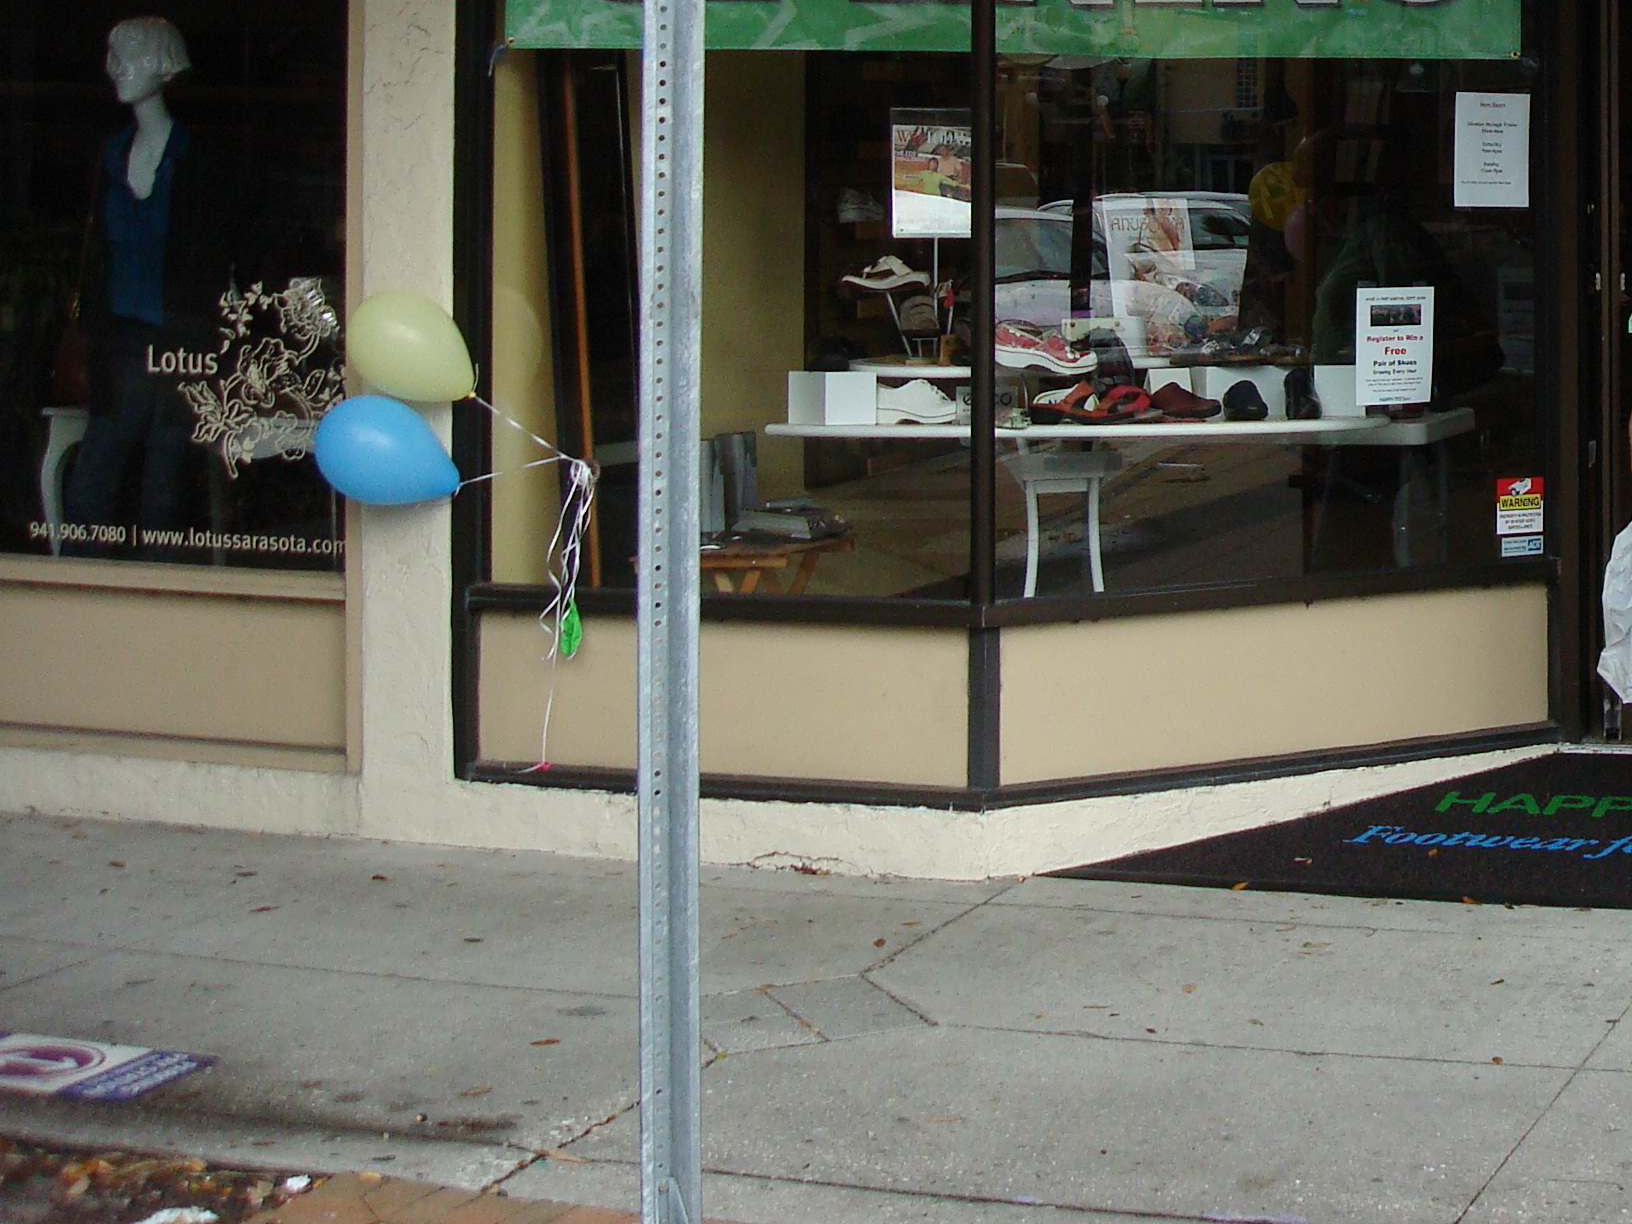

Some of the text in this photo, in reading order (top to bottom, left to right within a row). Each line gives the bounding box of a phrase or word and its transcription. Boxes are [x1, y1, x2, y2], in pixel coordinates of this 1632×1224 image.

[1366, 335, 1396, 343] Register
[147, 344, 218, 374] Lotus
[1384, 346, 1407, 356] Free
[1501, 496, 1540, 508] WARNING
[30, 522, 346, 554] 941.906.7080 www.lotussarasota.com
[1343, 825, 1600, 853] Footwear
